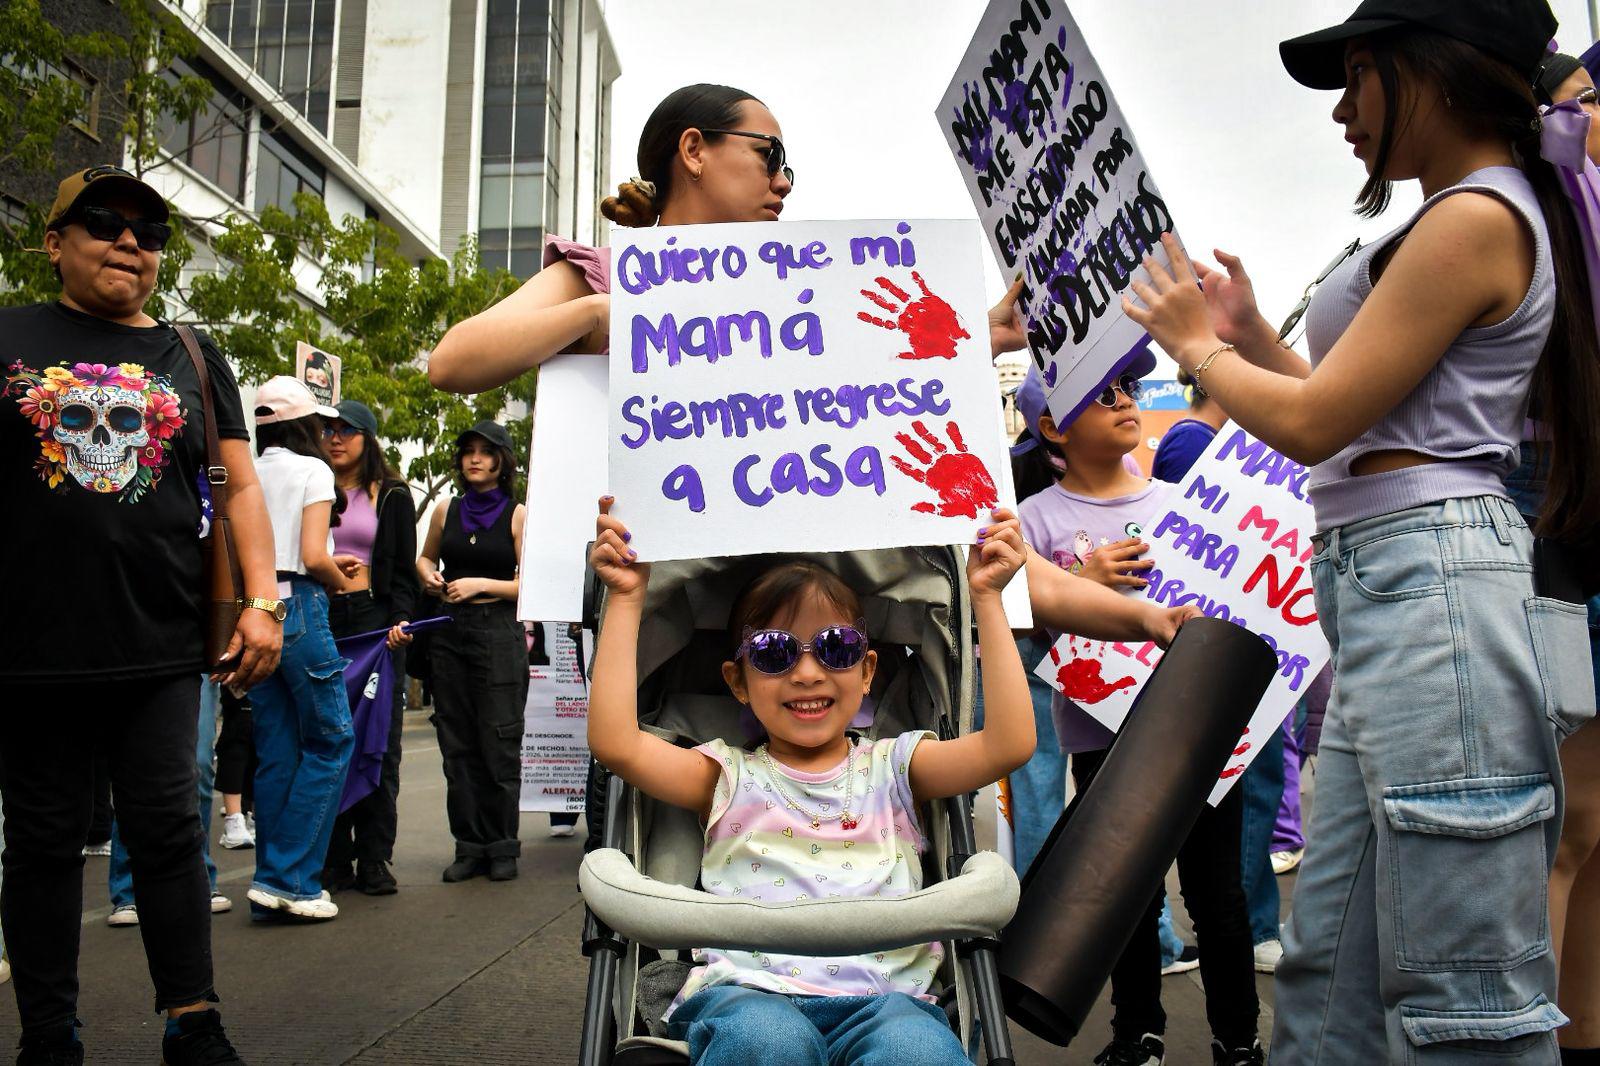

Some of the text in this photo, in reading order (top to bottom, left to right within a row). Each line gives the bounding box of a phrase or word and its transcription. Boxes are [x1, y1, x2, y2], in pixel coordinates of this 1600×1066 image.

[952, 0, 1052, 166] MI MAMI
[977, 135, 1015, 208] ME
[1029, 181, 1100, 285] LUCHAR
[1093, 127, 1134, 193] POR
[617, 222, 916, 295] Quiero que mi
[1027, 303, 1068, 372] MIS
[1051, 171, 1174, 345] DERECHOS
[631, 288, 825, 373] Mamá
[794, 378, 951, 429] regrese
[662, 464, 706, 512] a
[1184, 475, 1229, 514] MI
[1215, 429, 1313, 505] MARC
[1152, 510, 1319, 626] PARA NO
[542, 787, 576, 795] ALERTA
